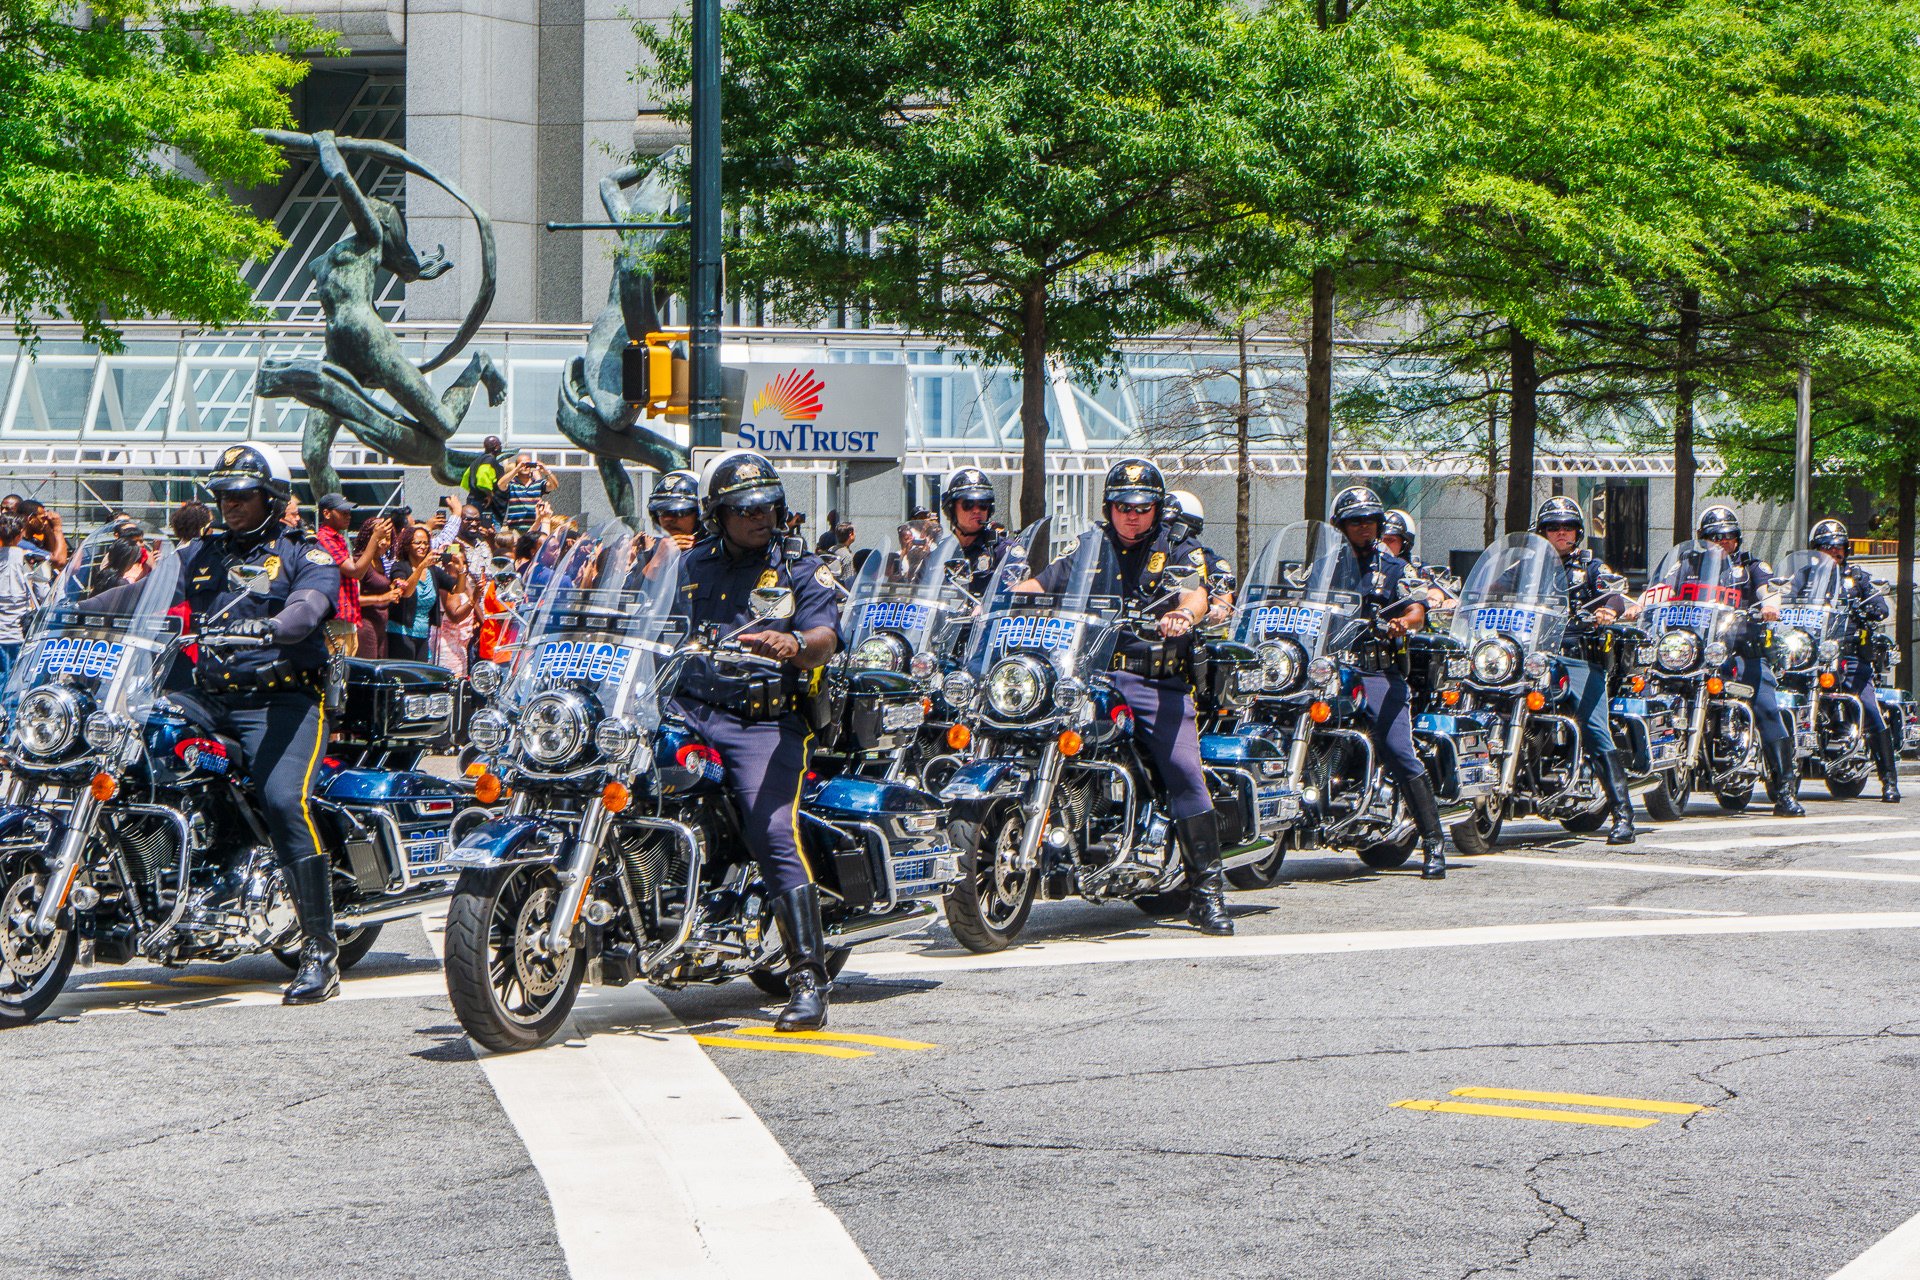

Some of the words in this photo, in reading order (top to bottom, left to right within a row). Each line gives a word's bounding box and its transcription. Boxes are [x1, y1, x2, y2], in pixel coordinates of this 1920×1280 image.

[1643, 583, 1742, 608] ATLANTA
[863, 602, 930, 631] POLICE
[1254, 606, 1325, 637] POLICE
[1474, 608, 1536, 634] POLICE
[1657, 605, 1712, 629] POLICE
[995, 616, 1077, 651] POLICE
[35, 637, 126, 681] POLICE
[536, 640, 632, 685] POLICE
[196, 751, 229, 775] POLICE
